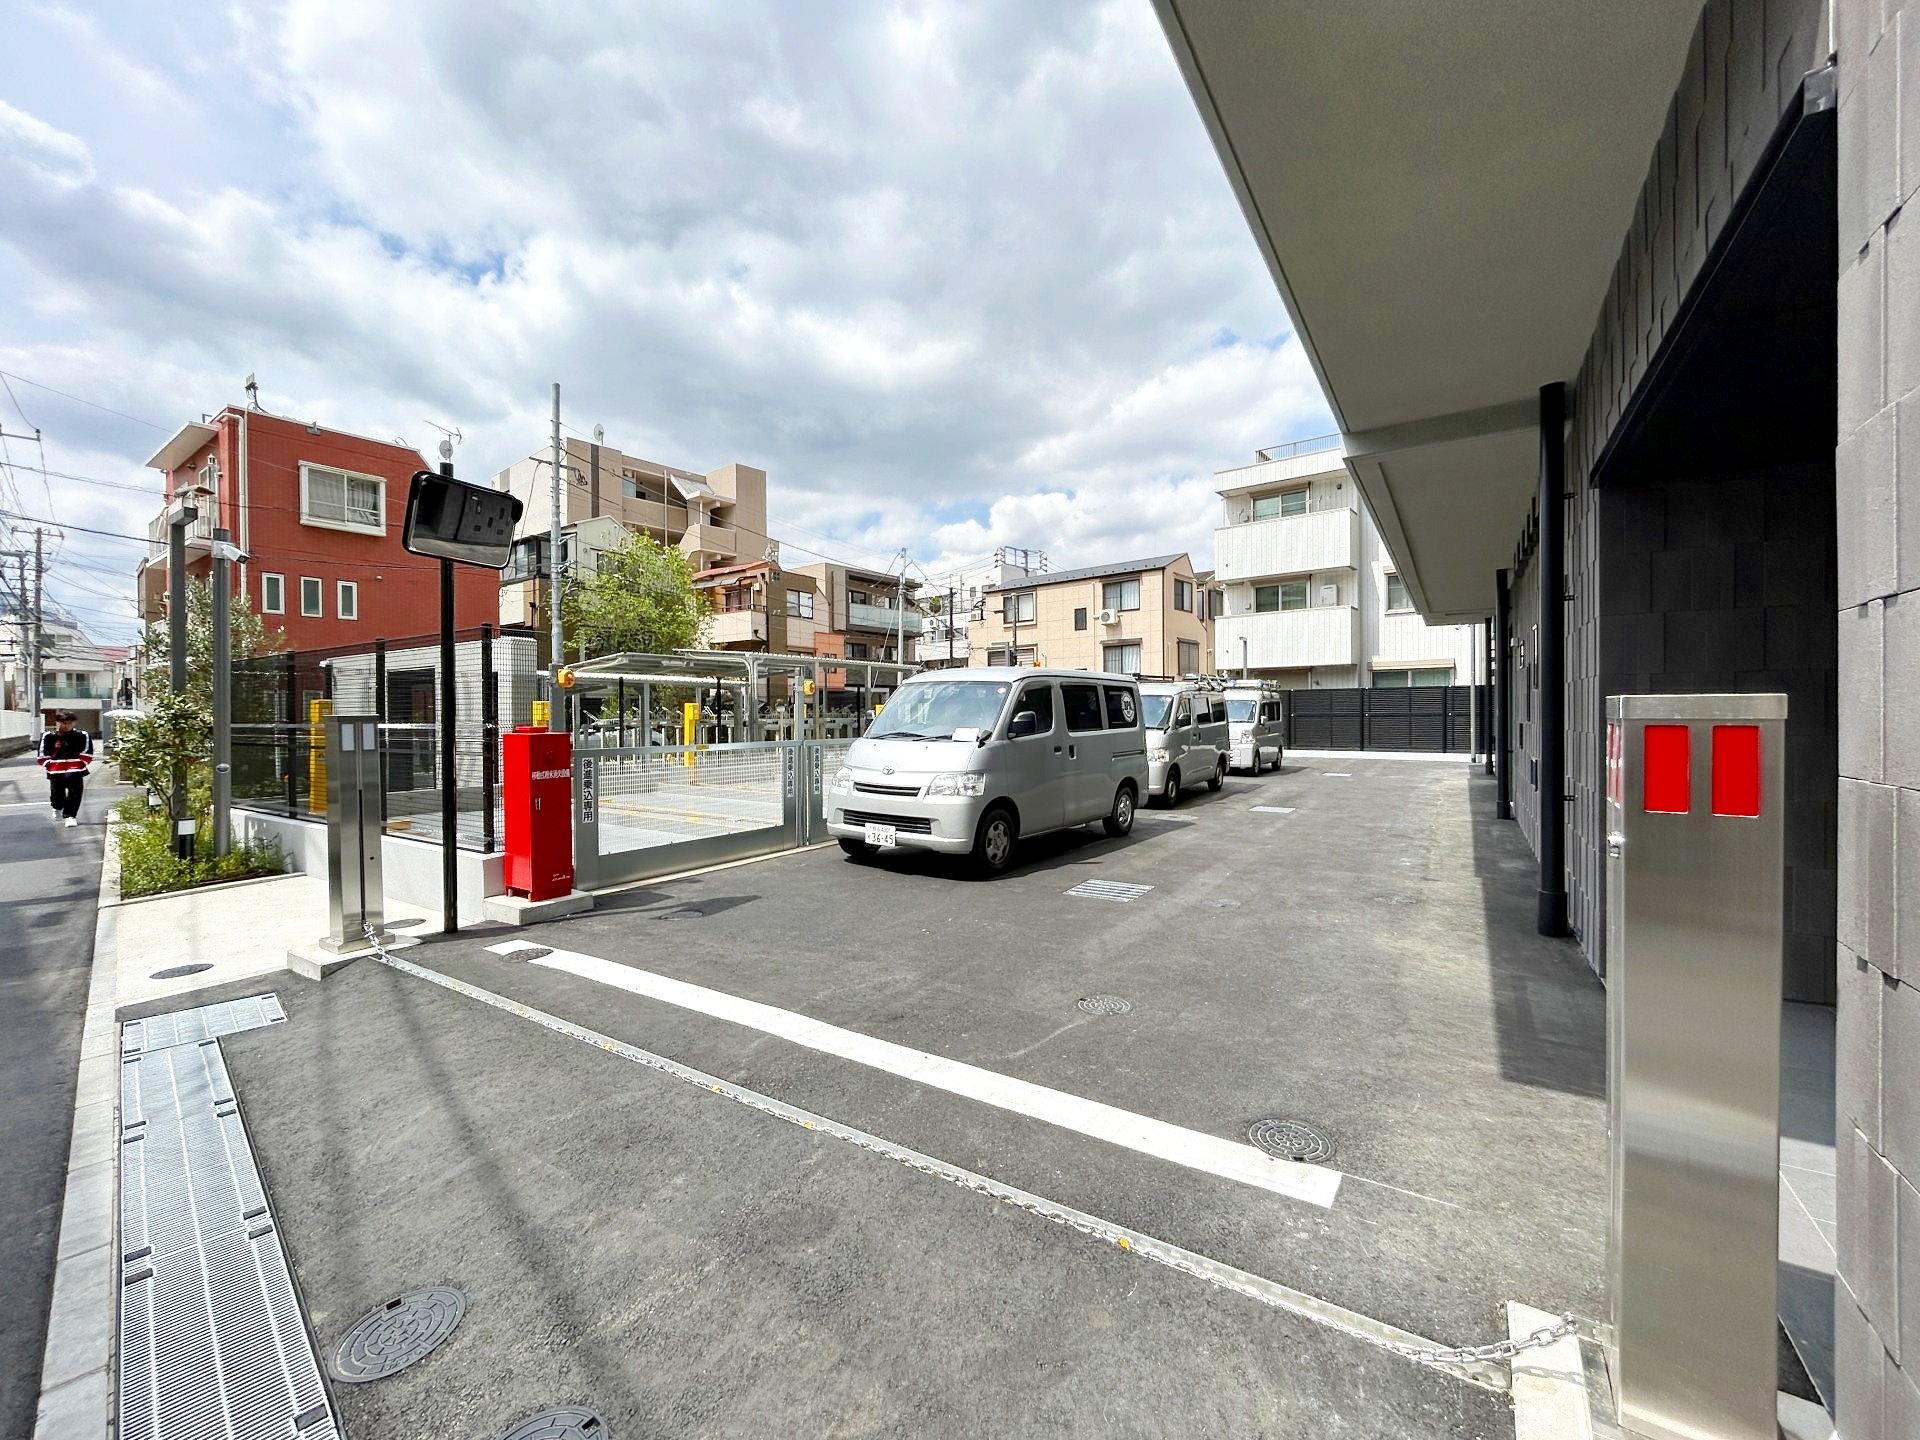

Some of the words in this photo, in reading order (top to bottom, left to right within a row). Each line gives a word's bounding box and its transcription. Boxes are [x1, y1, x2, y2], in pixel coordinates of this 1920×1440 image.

[582, 758, 593, 822] 後進乗込専用
